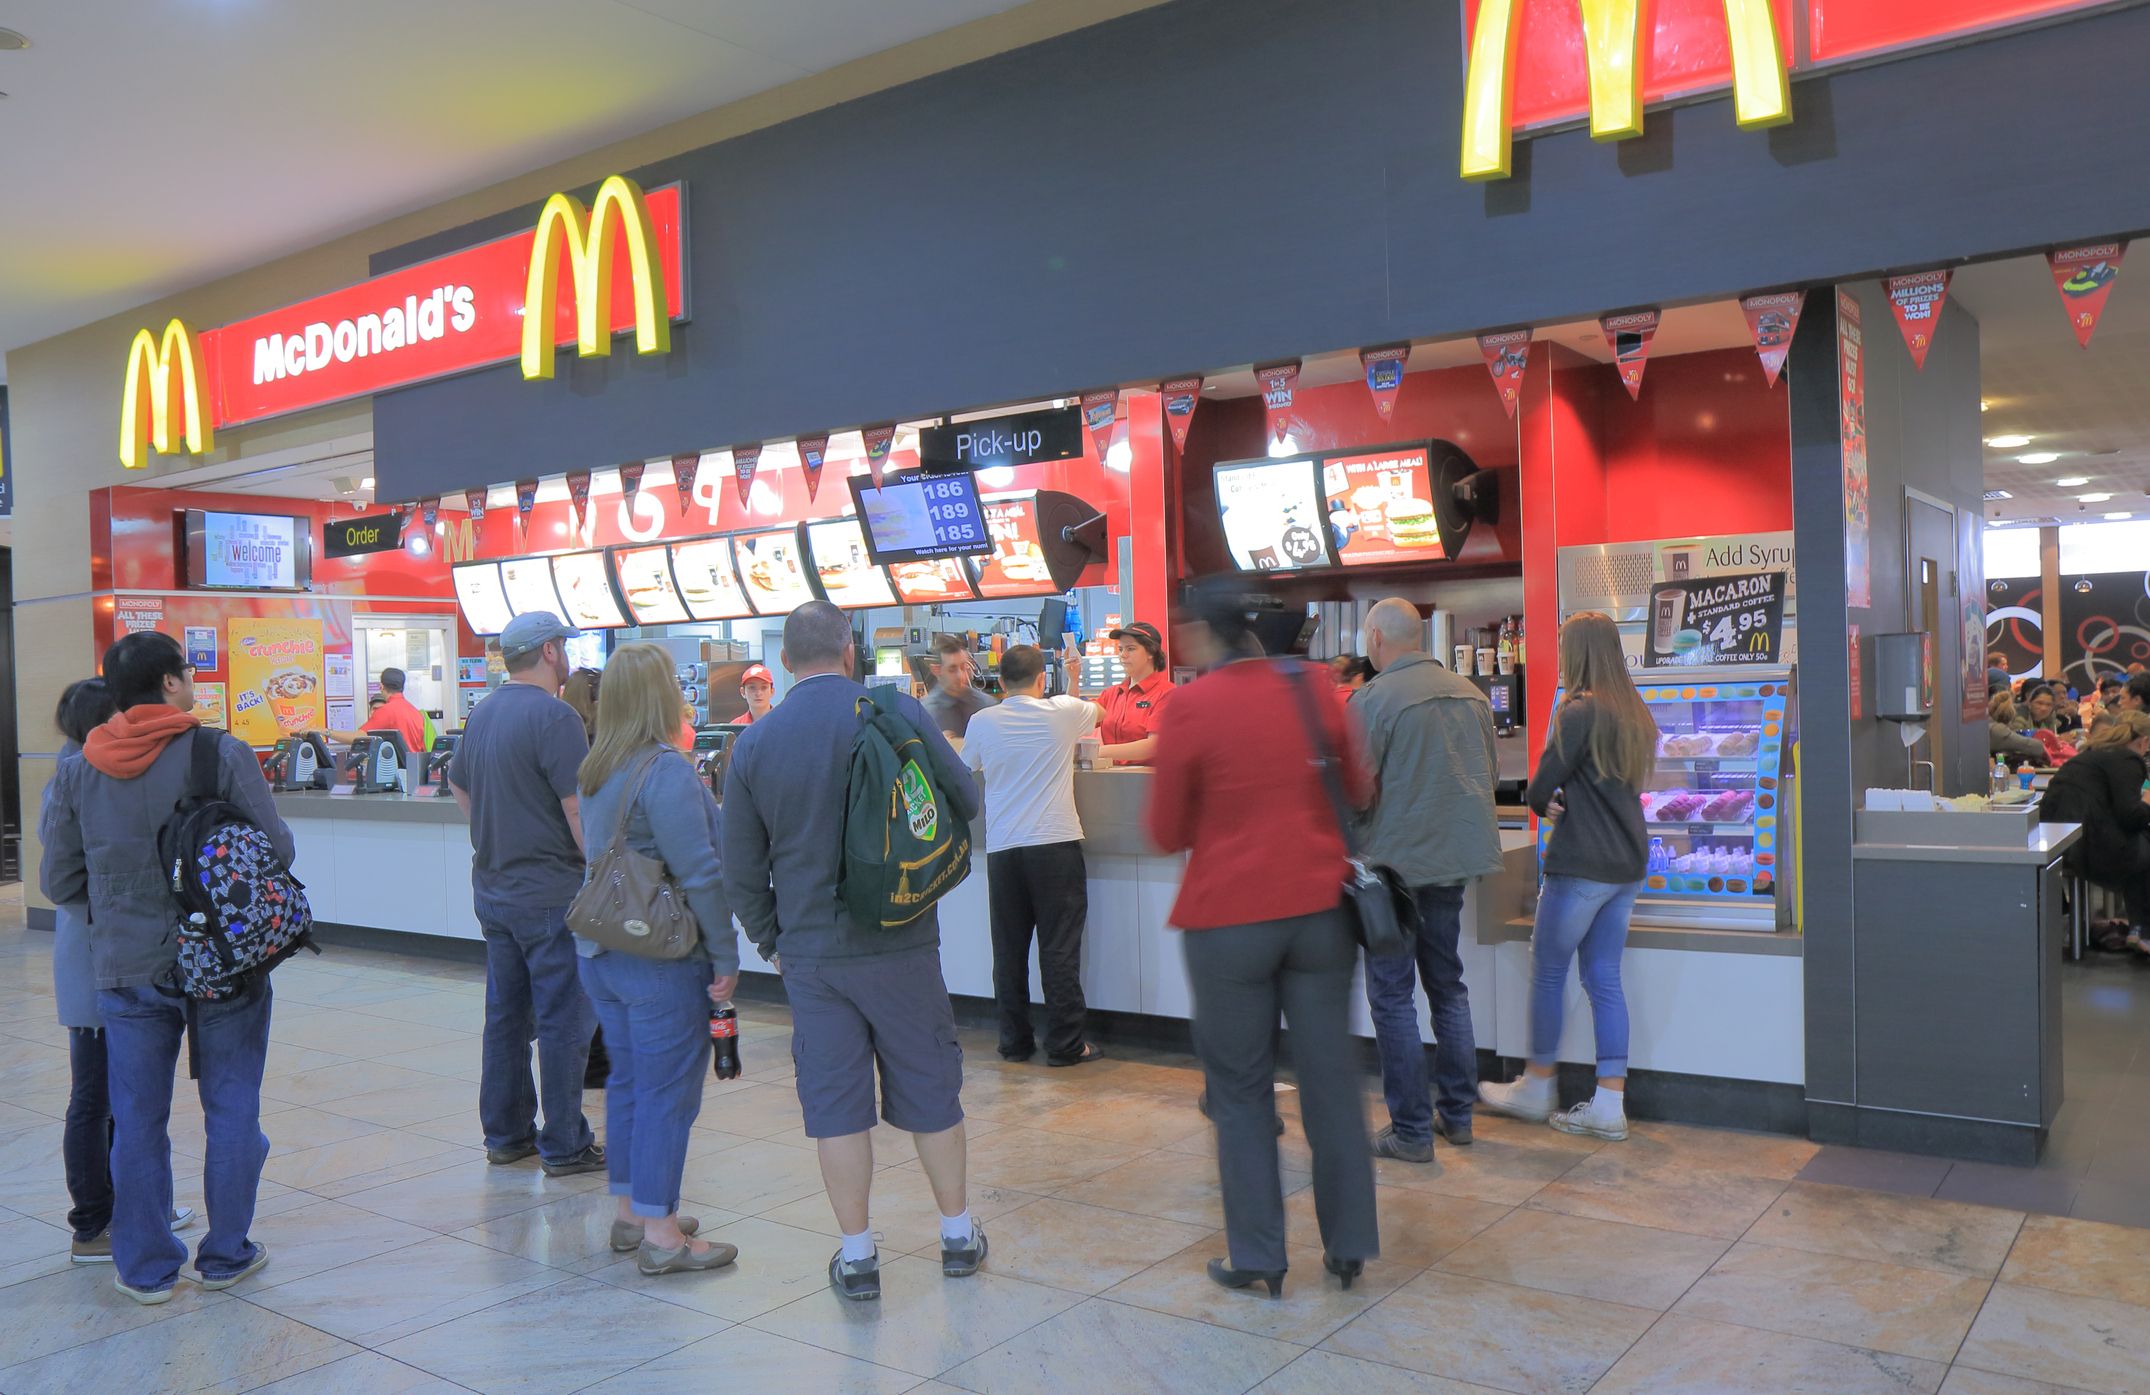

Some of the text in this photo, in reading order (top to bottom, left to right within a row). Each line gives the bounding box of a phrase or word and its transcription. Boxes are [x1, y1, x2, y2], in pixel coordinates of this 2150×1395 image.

[2058, 246, 2115, 260] MONOPOLY
[1893, 272, 1943, 287] MONOPOLY
[1891, 283, 1944, 299] MILLIONS
[1749, 296, 1796, 307] MONOPOLY
[1896, 293, 1939, 305] OF PRIZES
[1904, 302, 1930, 312] TO BE
[1609, 314, 1651, 327] MONOPOLY
[1904, 310, 1930, 320] WON!
[253, 285, 475, 385] McDonald's
[1485, 333, 1524, 345] MONOPOLY
[1367, 349, 1403, 359] MONOPOLY
[1261, 367, 1295, 378] MONOPOLY
[1166, 381, 1198, 390] MONOPOLY
[1086, 393, 1113, 401] MONOPOLY
[1264, 388, 1292, 404] WIN
[956, 429, 1041, 460] Pick-up
[900, 474, 919, 482] Your
[924, 481, 963, 500] 186
[930, 503, 968, 520] 189
[346, 526, 380, 546] Order
[935, 524, 975, 542] 185
[1706, 544, 1742, 567] Add
[1689, 574, 1772, 609] MACARON
[1698, 602, 1740, 618] STANDARD
[1742, 594, 1775, 607] COFFEE
[118, 611, 163, 620] ALL THESE
[1715, 653, 1738, 662] COFFEE
[1738, 652, 1755, 660] ONLY
[238, 690, 255, 702] IT'S
[236, 695, 264, 712] BACK!
[912, 807, 935, 833] MILO
